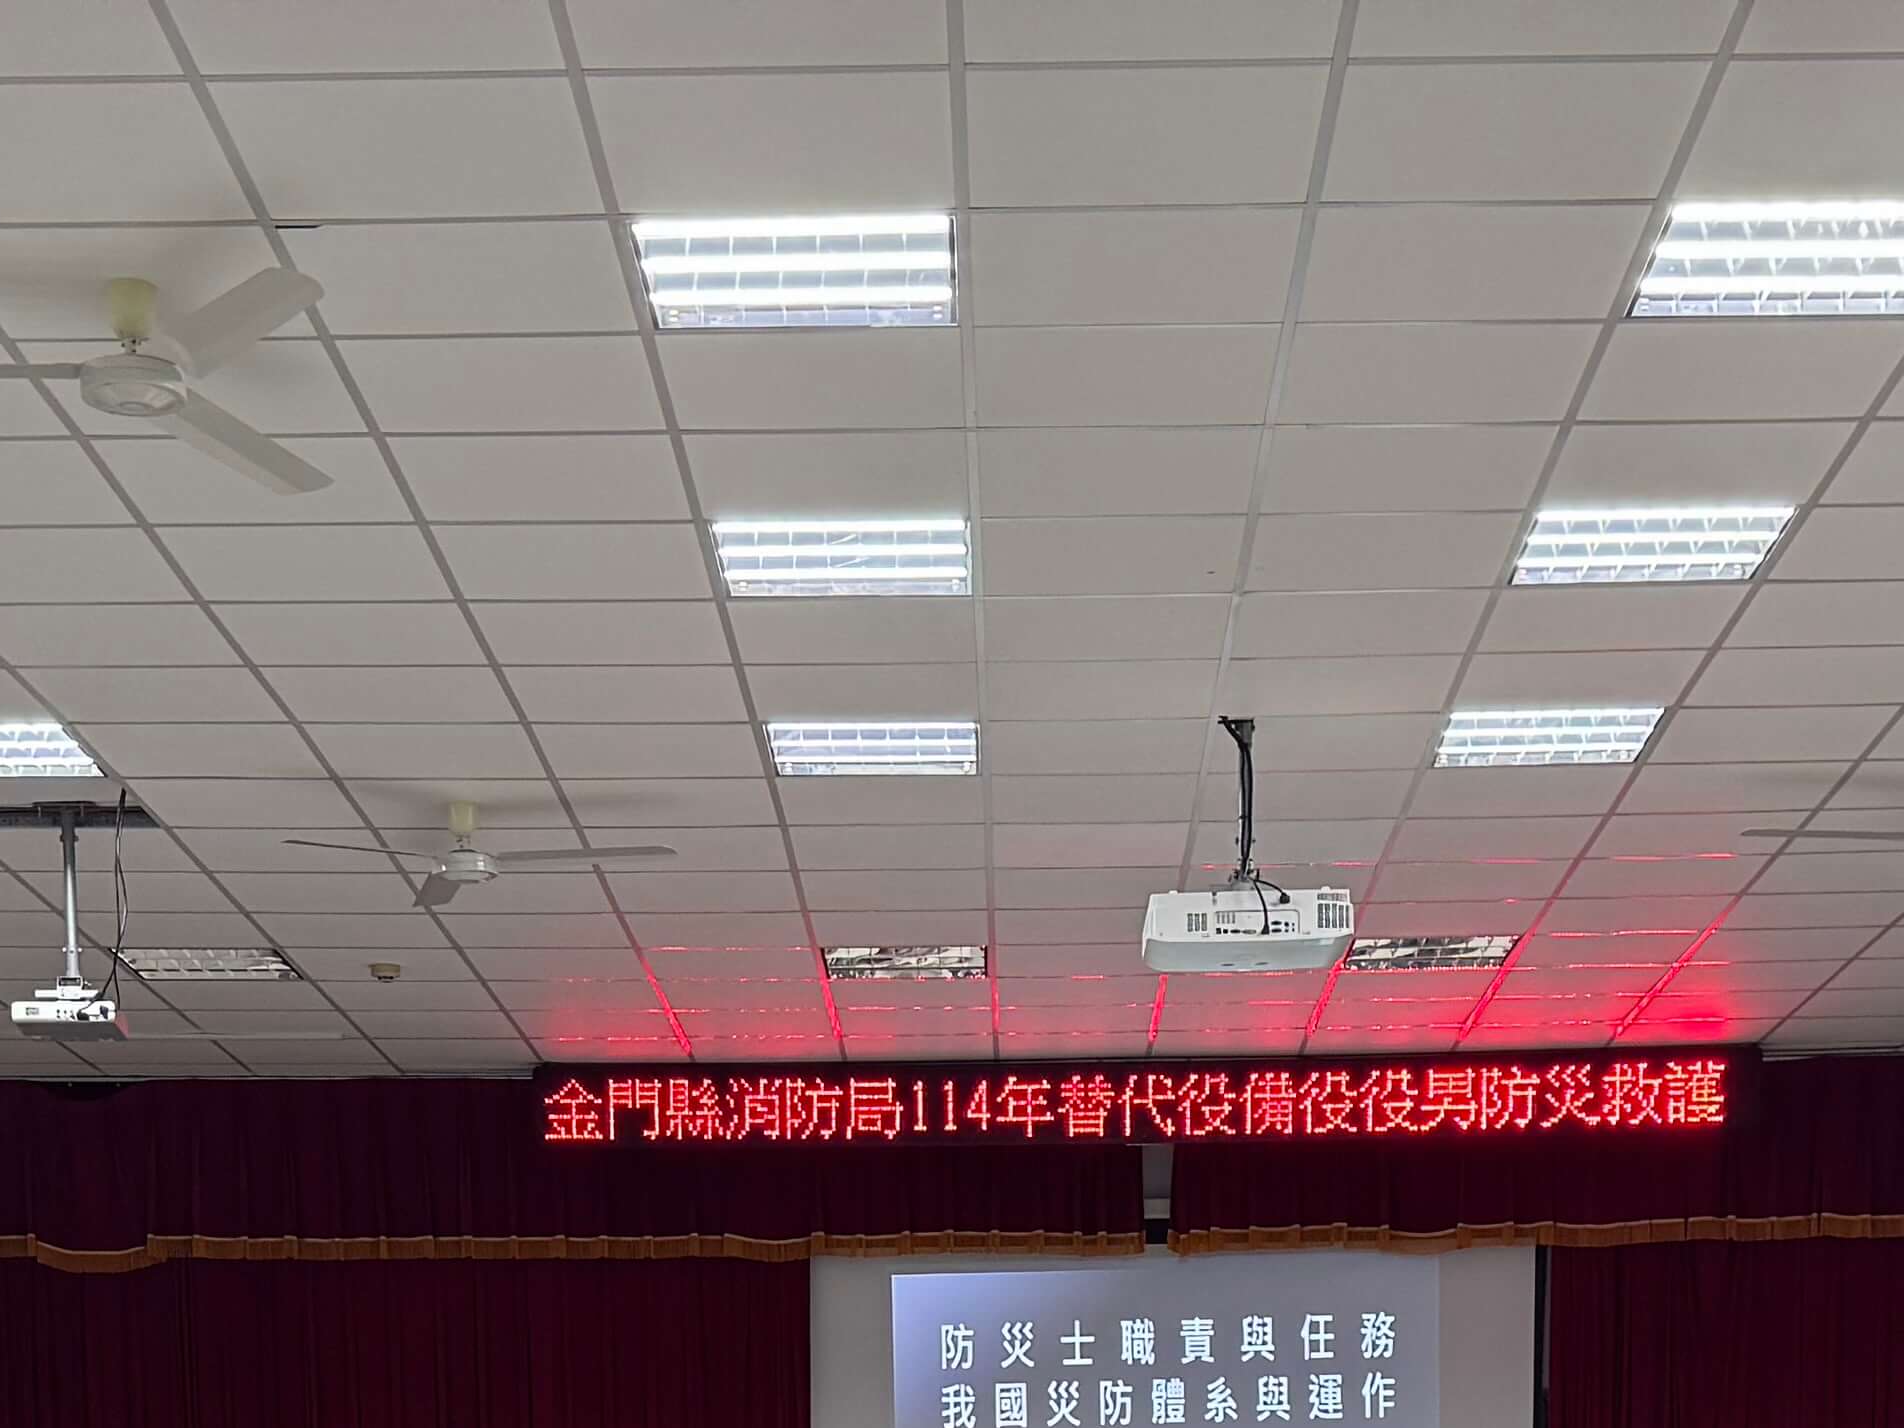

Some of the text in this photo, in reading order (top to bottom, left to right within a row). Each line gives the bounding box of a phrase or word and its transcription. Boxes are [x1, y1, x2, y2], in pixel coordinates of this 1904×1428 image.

[544, 1061, 1726, 1141] 金門縣消防局114年替代役備役役男防災救護
[939, 1311, 1397, 1371] 防災士職責與任務
